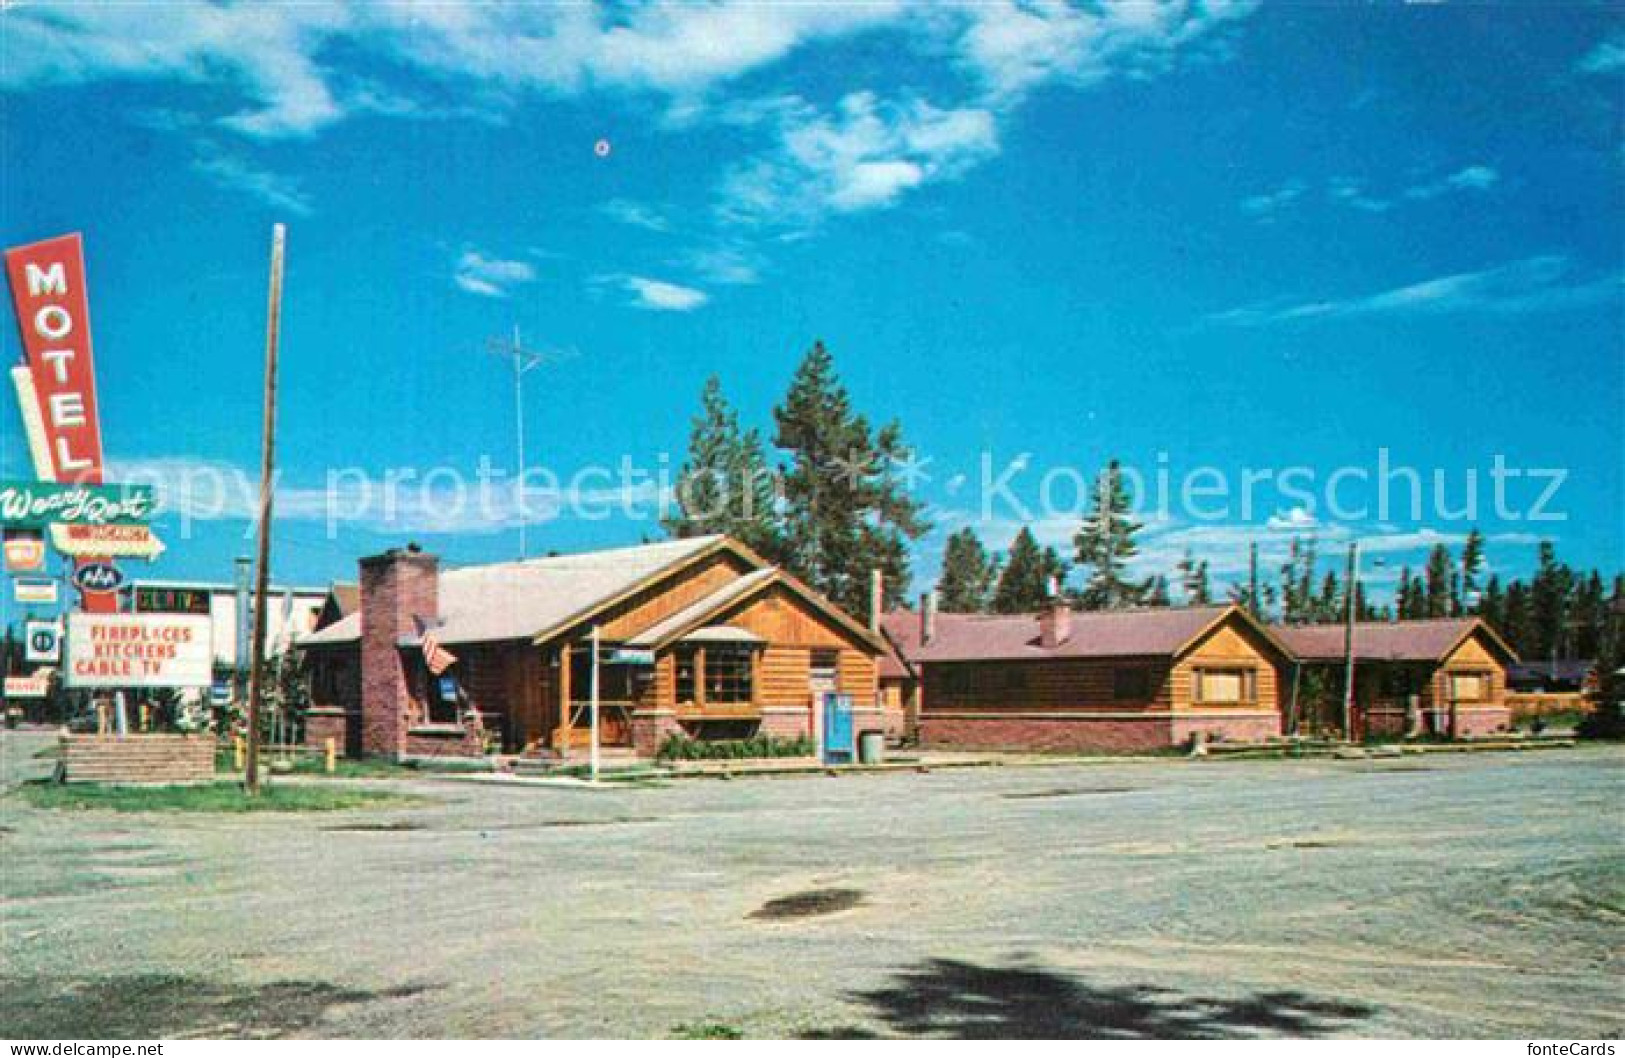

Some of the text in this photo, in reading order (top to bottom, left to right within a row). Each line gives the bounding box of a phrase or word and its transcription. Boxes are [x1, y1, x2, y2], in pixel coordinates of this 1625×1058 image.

[25, 261, 93, 470] MOTEL
[94, 642, 177, 659] KITCHENS
[75, 660, 161, 676] CABLE TV
